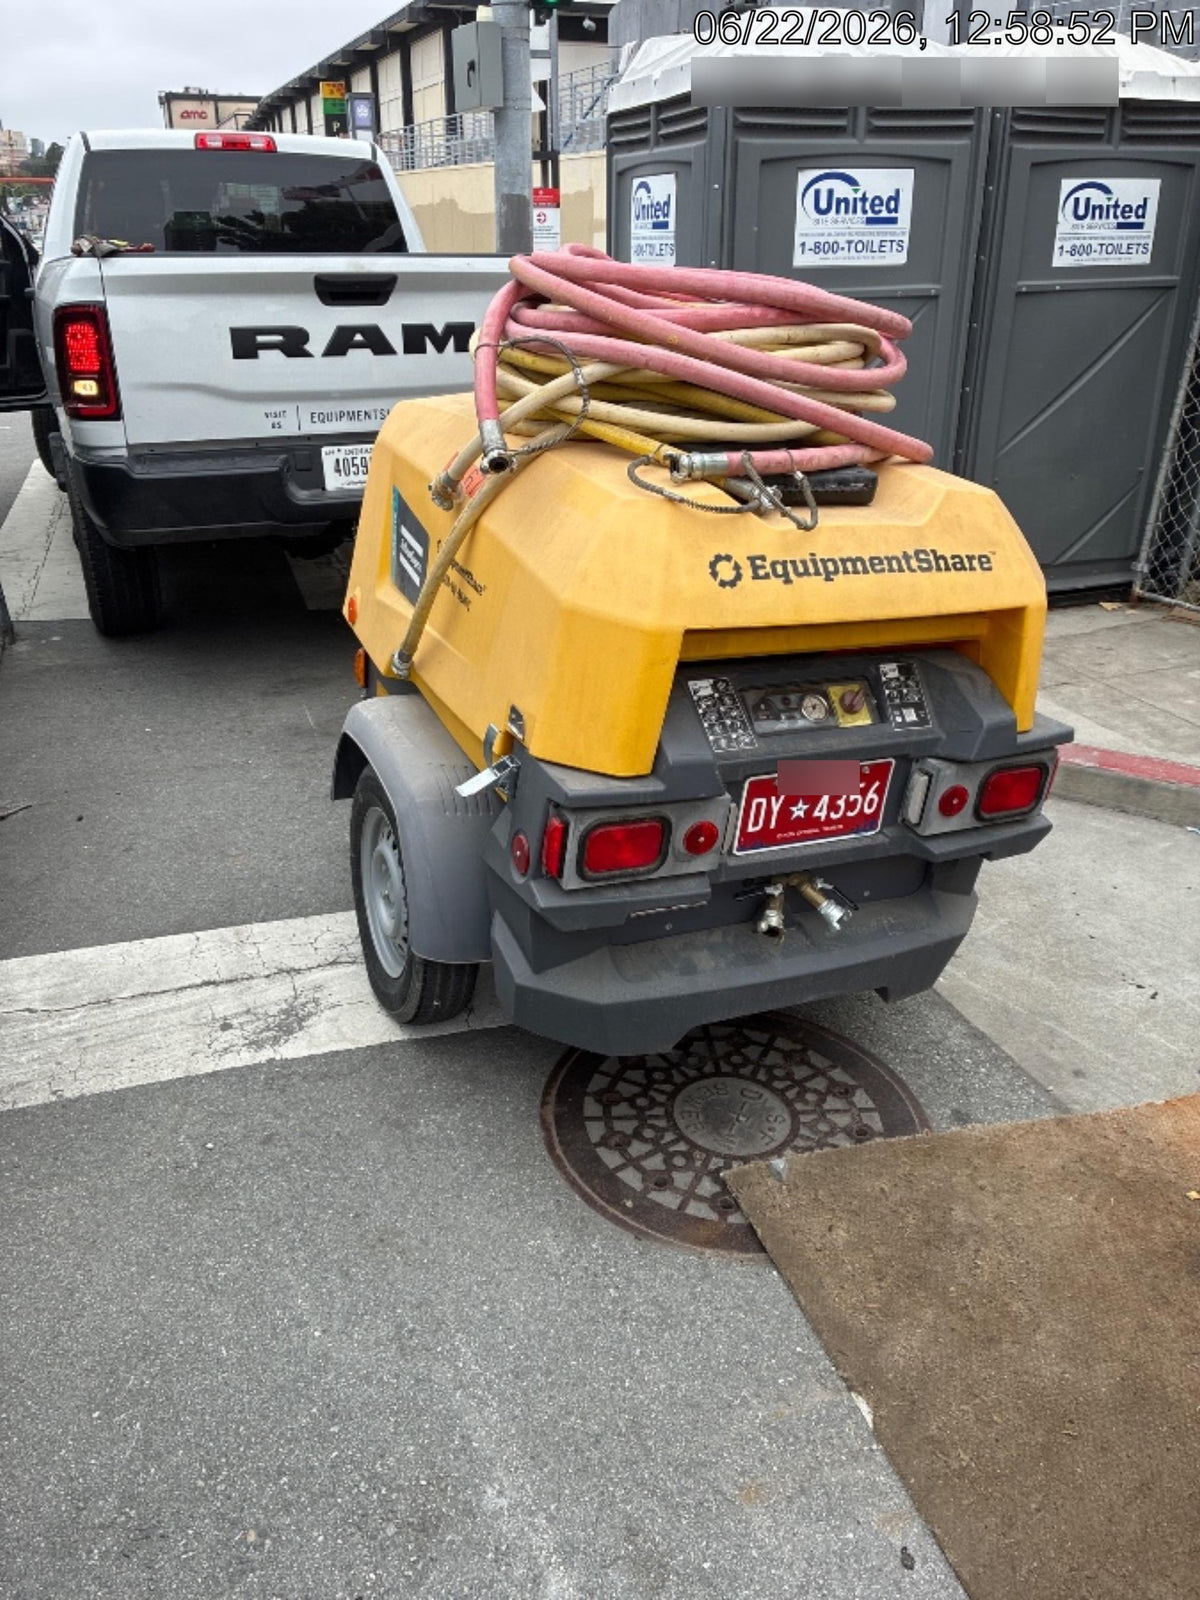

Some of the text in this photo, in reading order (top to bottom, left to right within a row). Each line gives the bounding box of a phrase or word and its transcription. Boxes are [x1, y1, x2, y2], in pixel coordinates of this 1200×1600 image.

[633, 193, 671, 221] United
[814, 188, 901, 216] United
[1073, 196, 1148, 221] United
[799, 239, 905, 255] 1-800-TOILETS
[1058, 243, 1149, 257] 1-800-TOILETS
[229, 321, 475, 359] RAM
[334, 456, 372, 477] 4059
[747, 549, 993, 586] EquipmentShare
